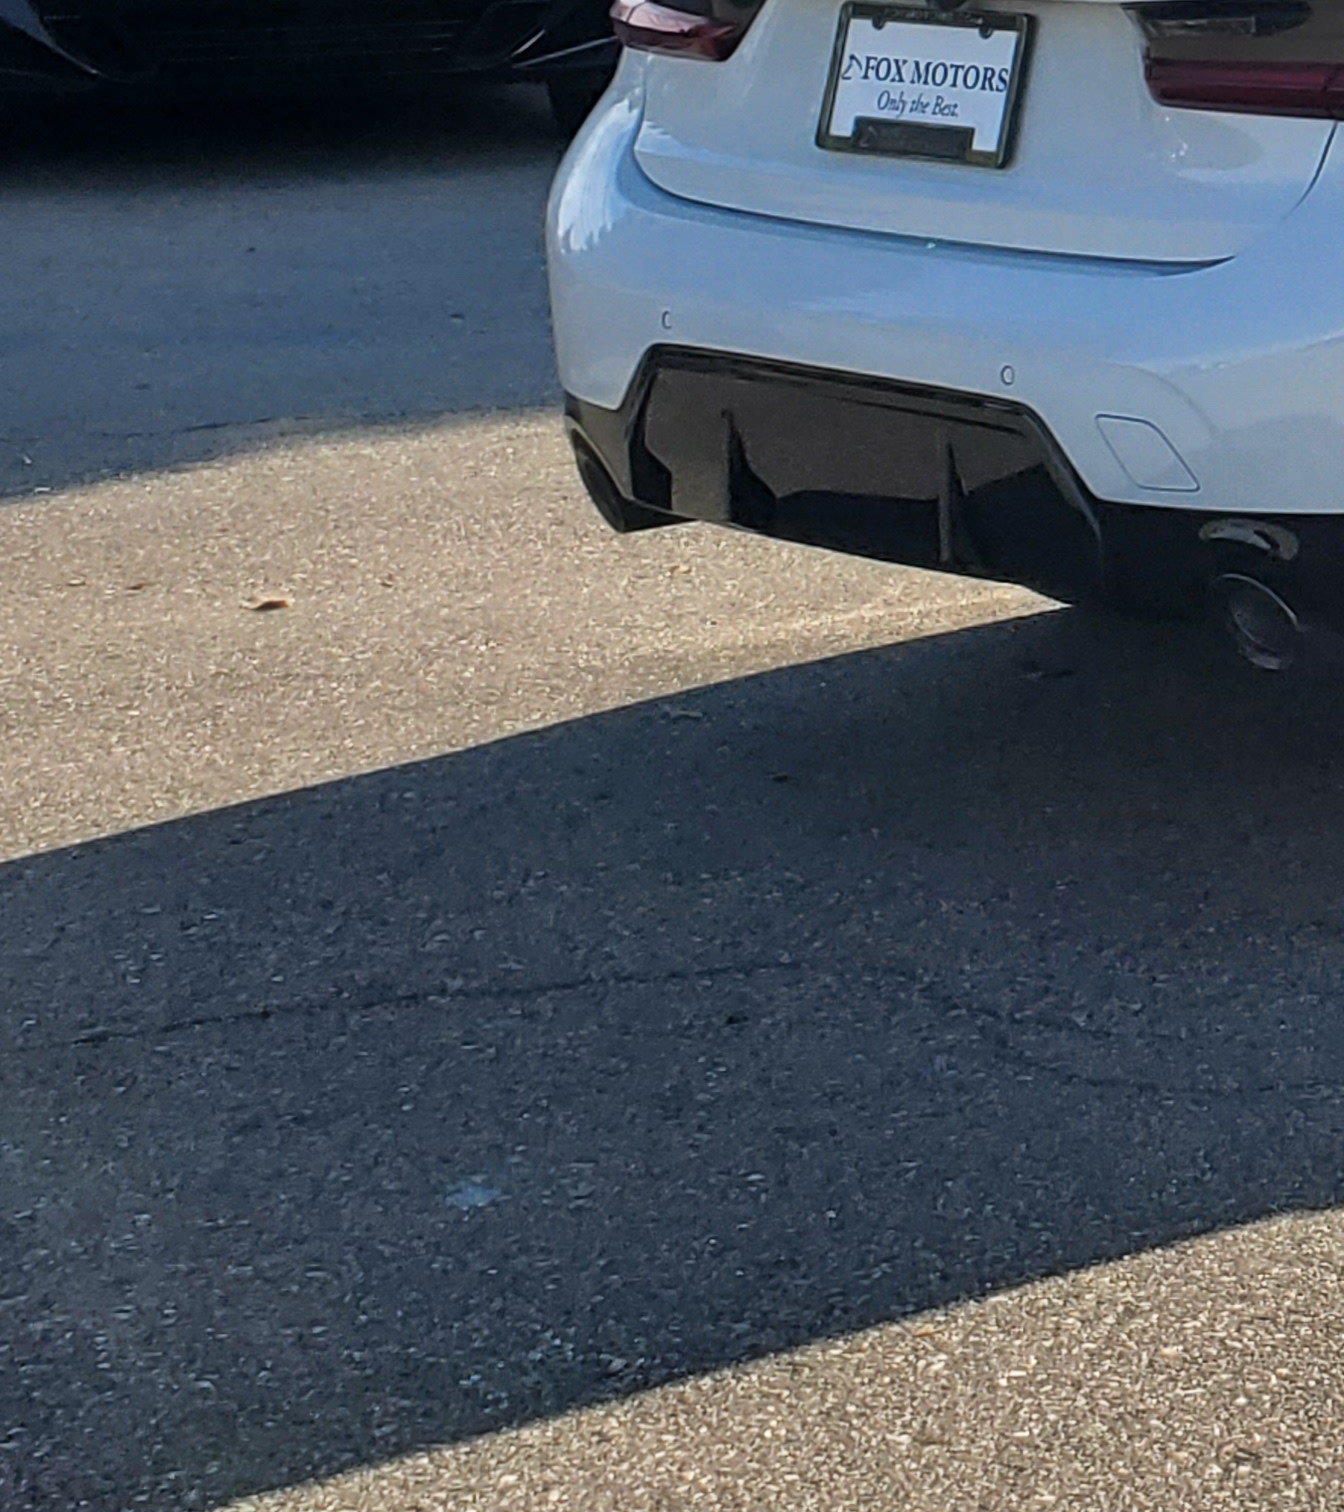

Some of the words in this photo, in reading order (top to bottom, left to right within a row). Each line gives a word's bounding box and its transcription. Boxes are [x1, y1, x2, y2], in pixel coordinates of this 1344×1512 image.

[862, 56, 907, 83] FOX
[910, 61, 1009, 92] MOTORS
[877, 90, 906, 119] Only
[909, 93, 930, 114] the
